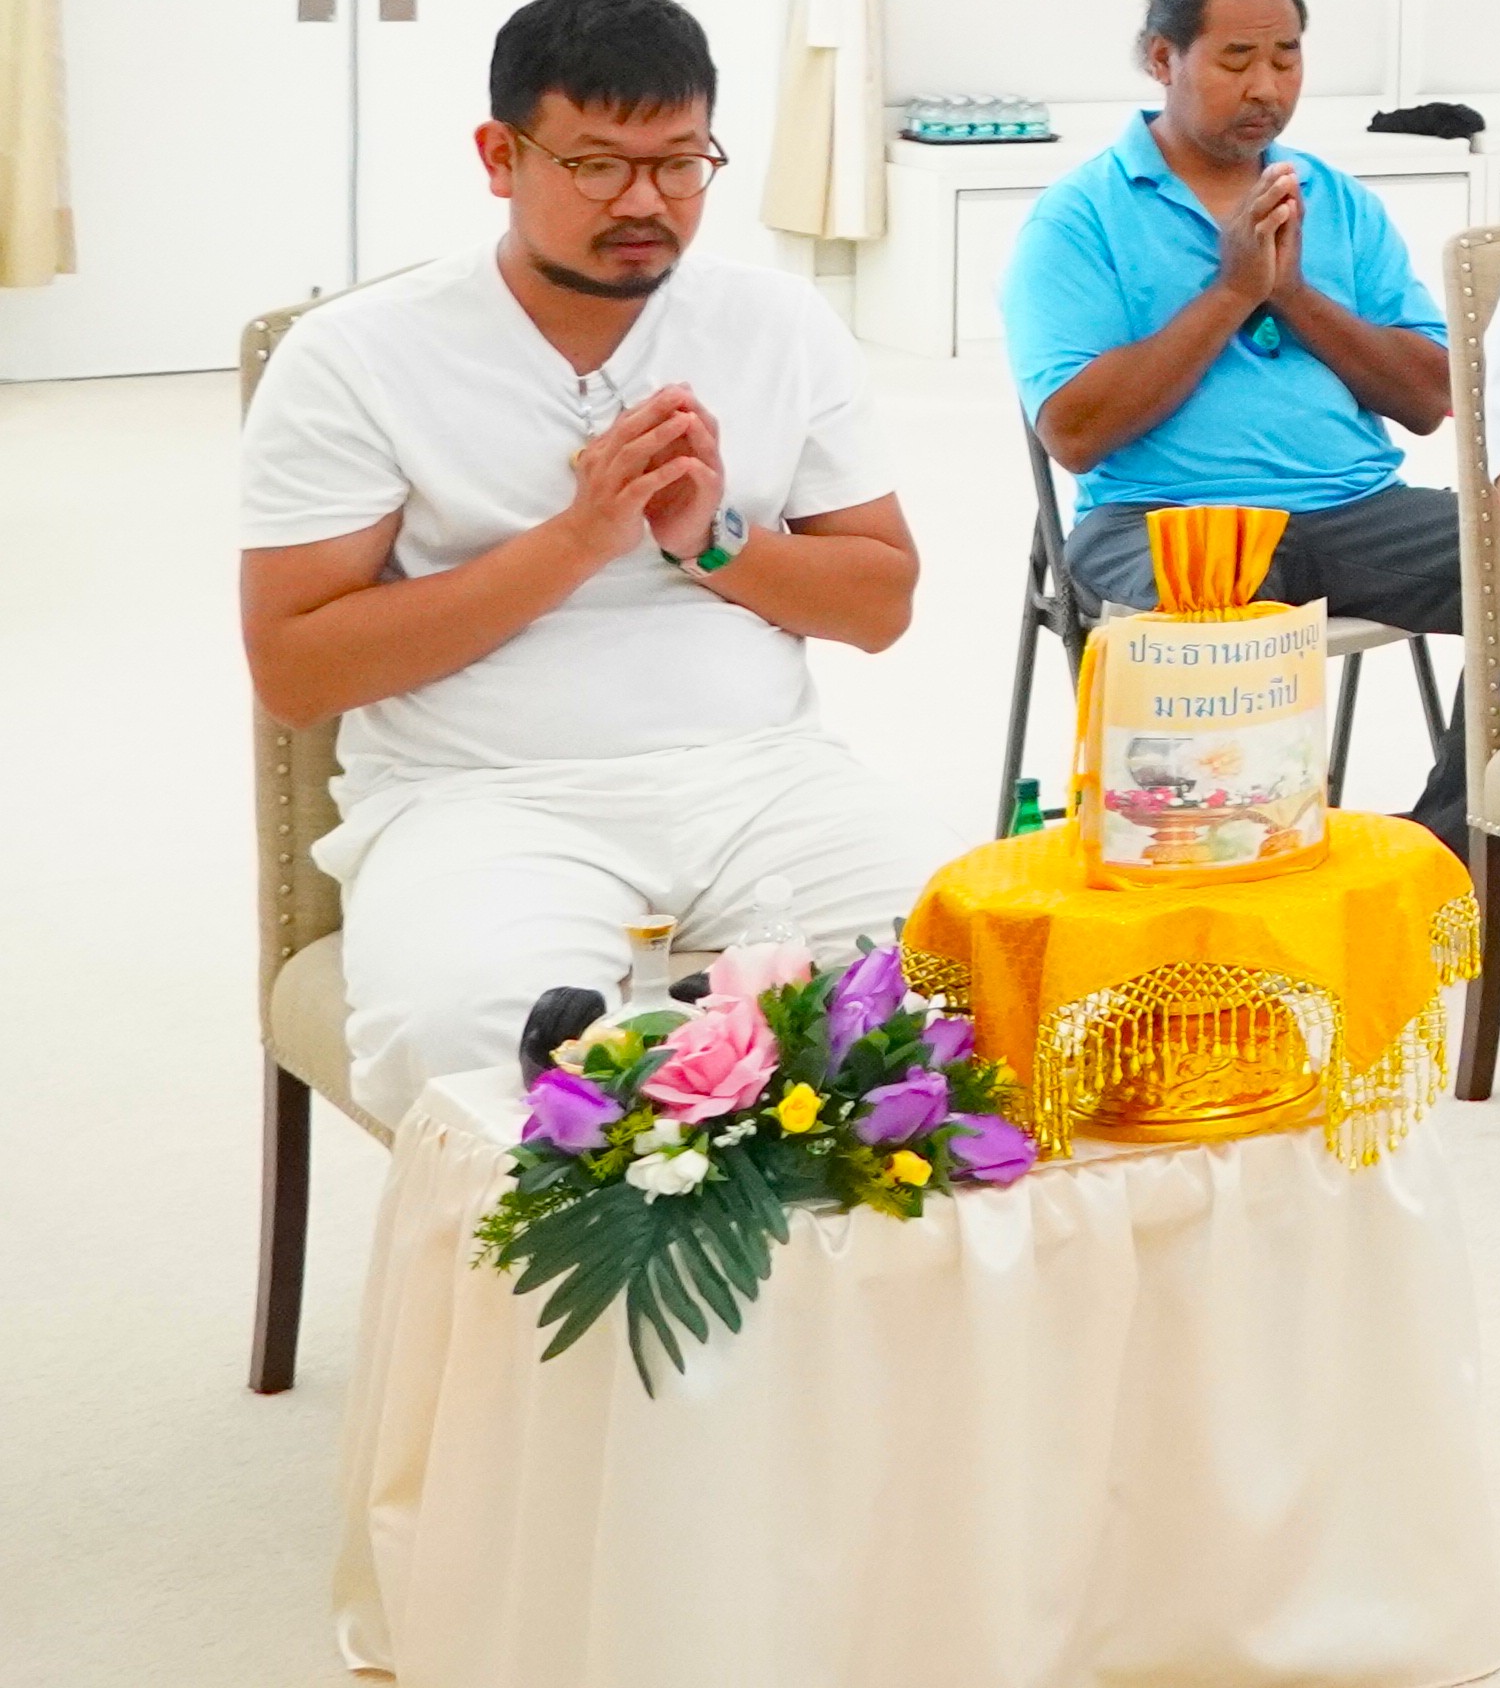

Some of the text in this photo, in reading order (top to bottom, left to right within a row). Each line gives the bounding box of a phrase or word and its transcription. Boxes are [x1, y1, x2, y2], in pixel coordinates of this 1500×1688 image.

[1128, 622, 1320, 666] ประธานกองบุญ
[1154, 673, 1299, 718] มาฆประทีป
